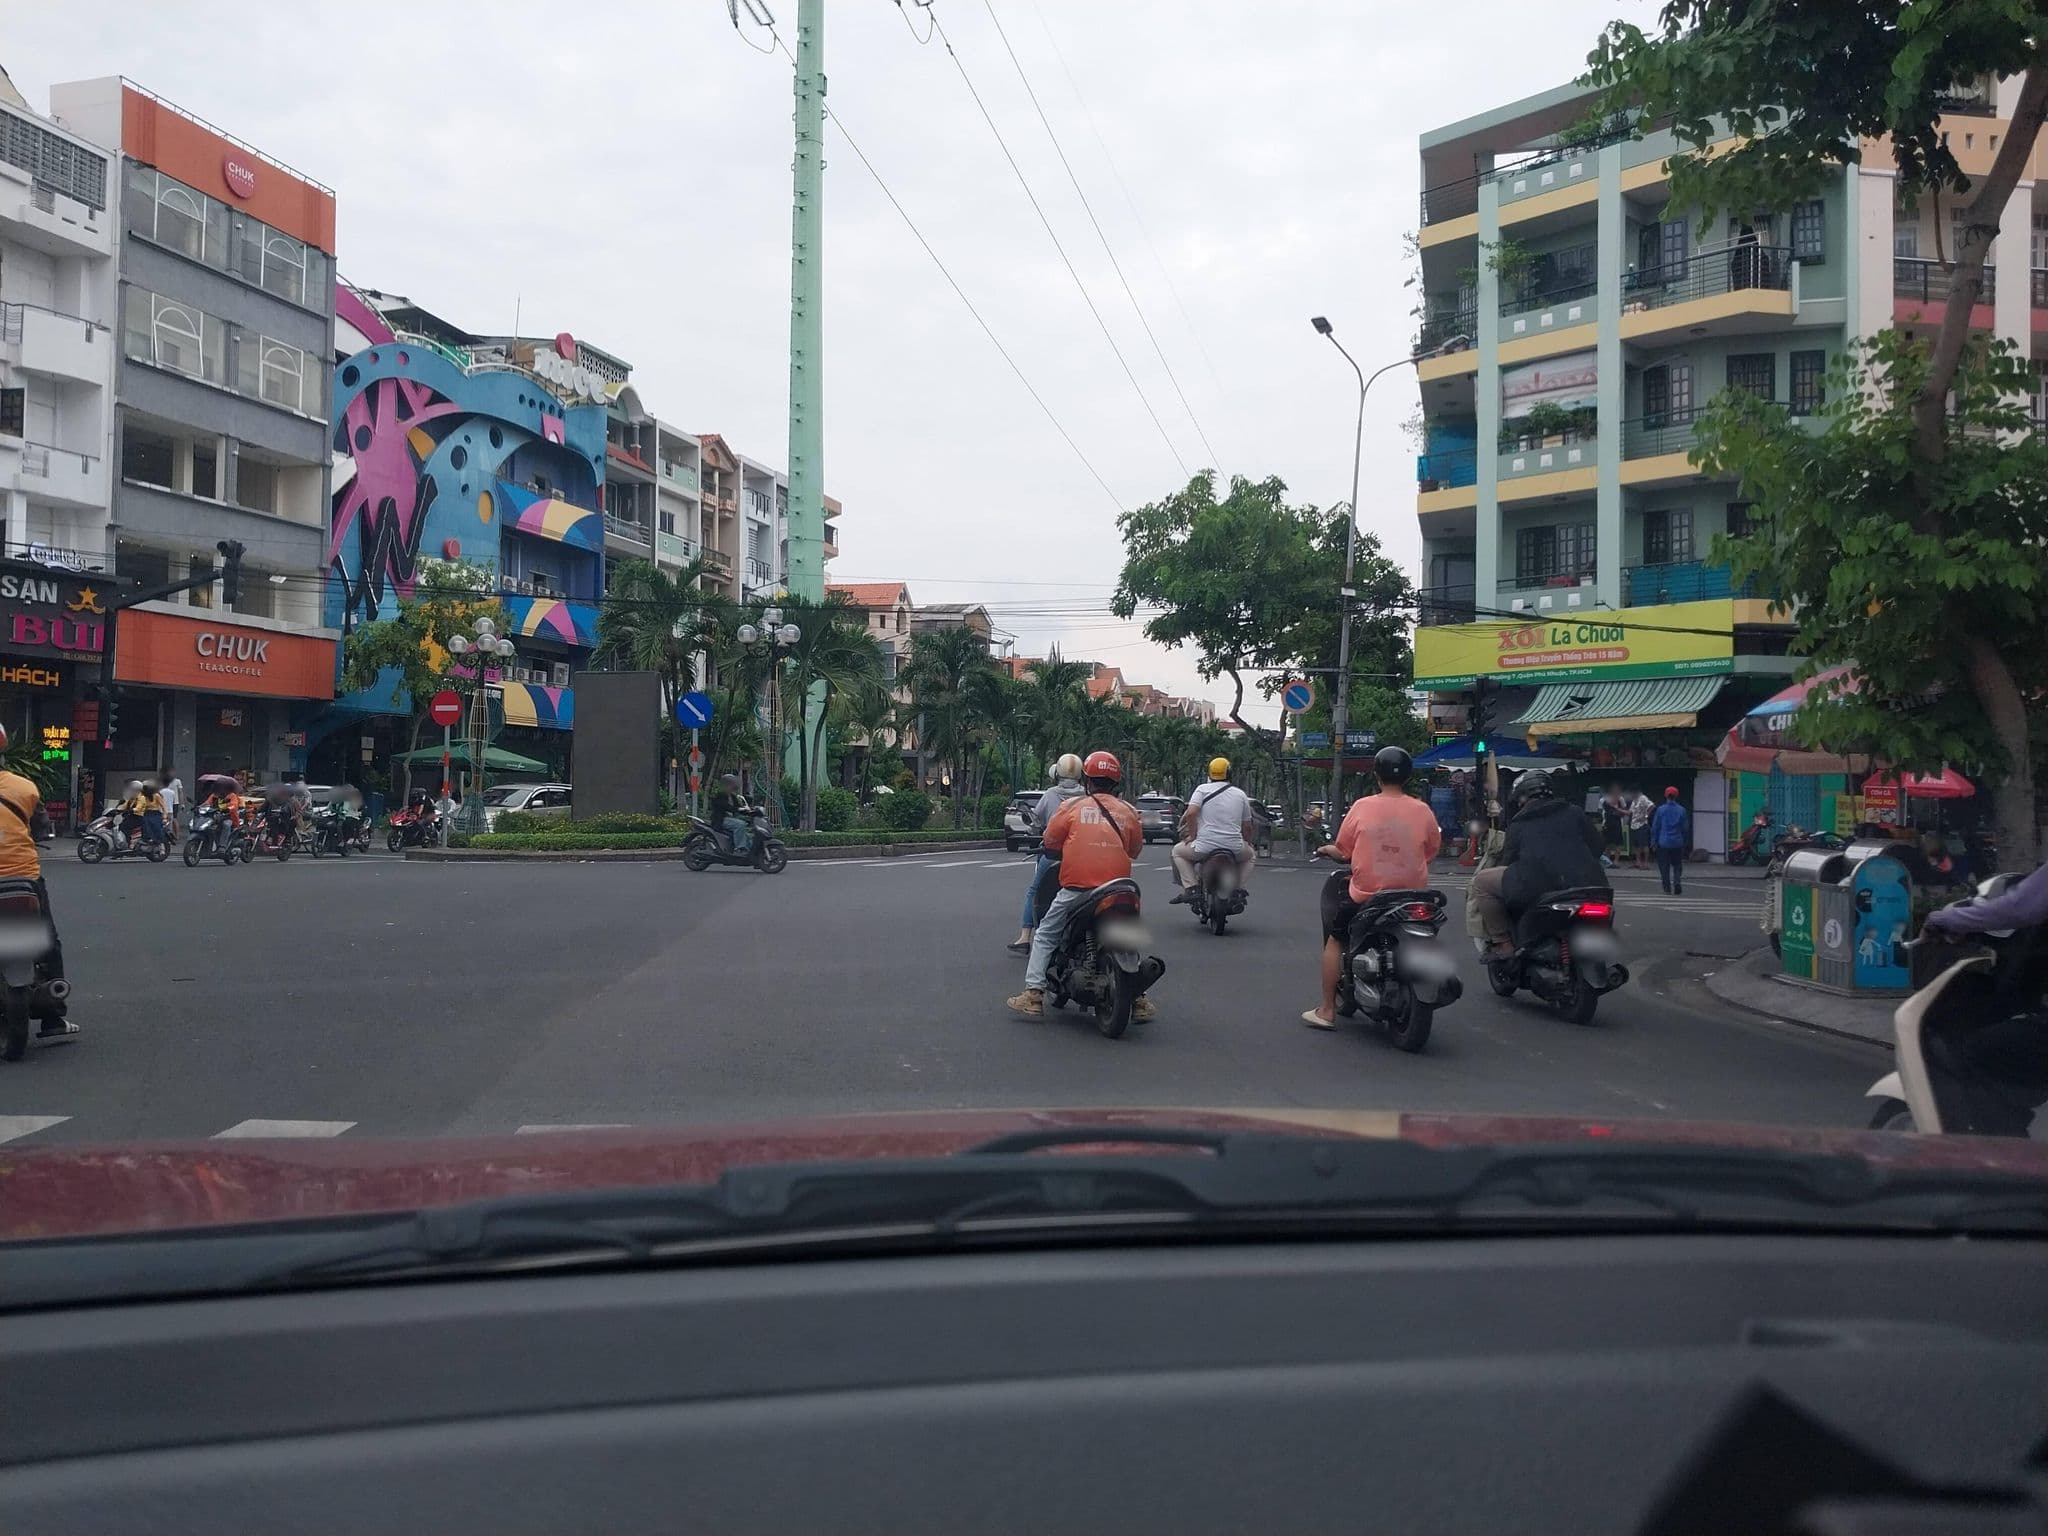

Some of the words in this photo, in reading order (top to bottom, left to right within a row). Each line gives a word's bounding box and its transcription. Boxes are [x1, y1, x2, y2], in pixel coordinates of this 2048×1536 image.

[227, 161, 255, 183] CHUK
[0, 575, 58, 605] SẠN
[197, 633, 270, 663] CHUK
[0, 663, 60, 687] HÁCH
[199, 662, 263, 677] TEA&COFFEE
